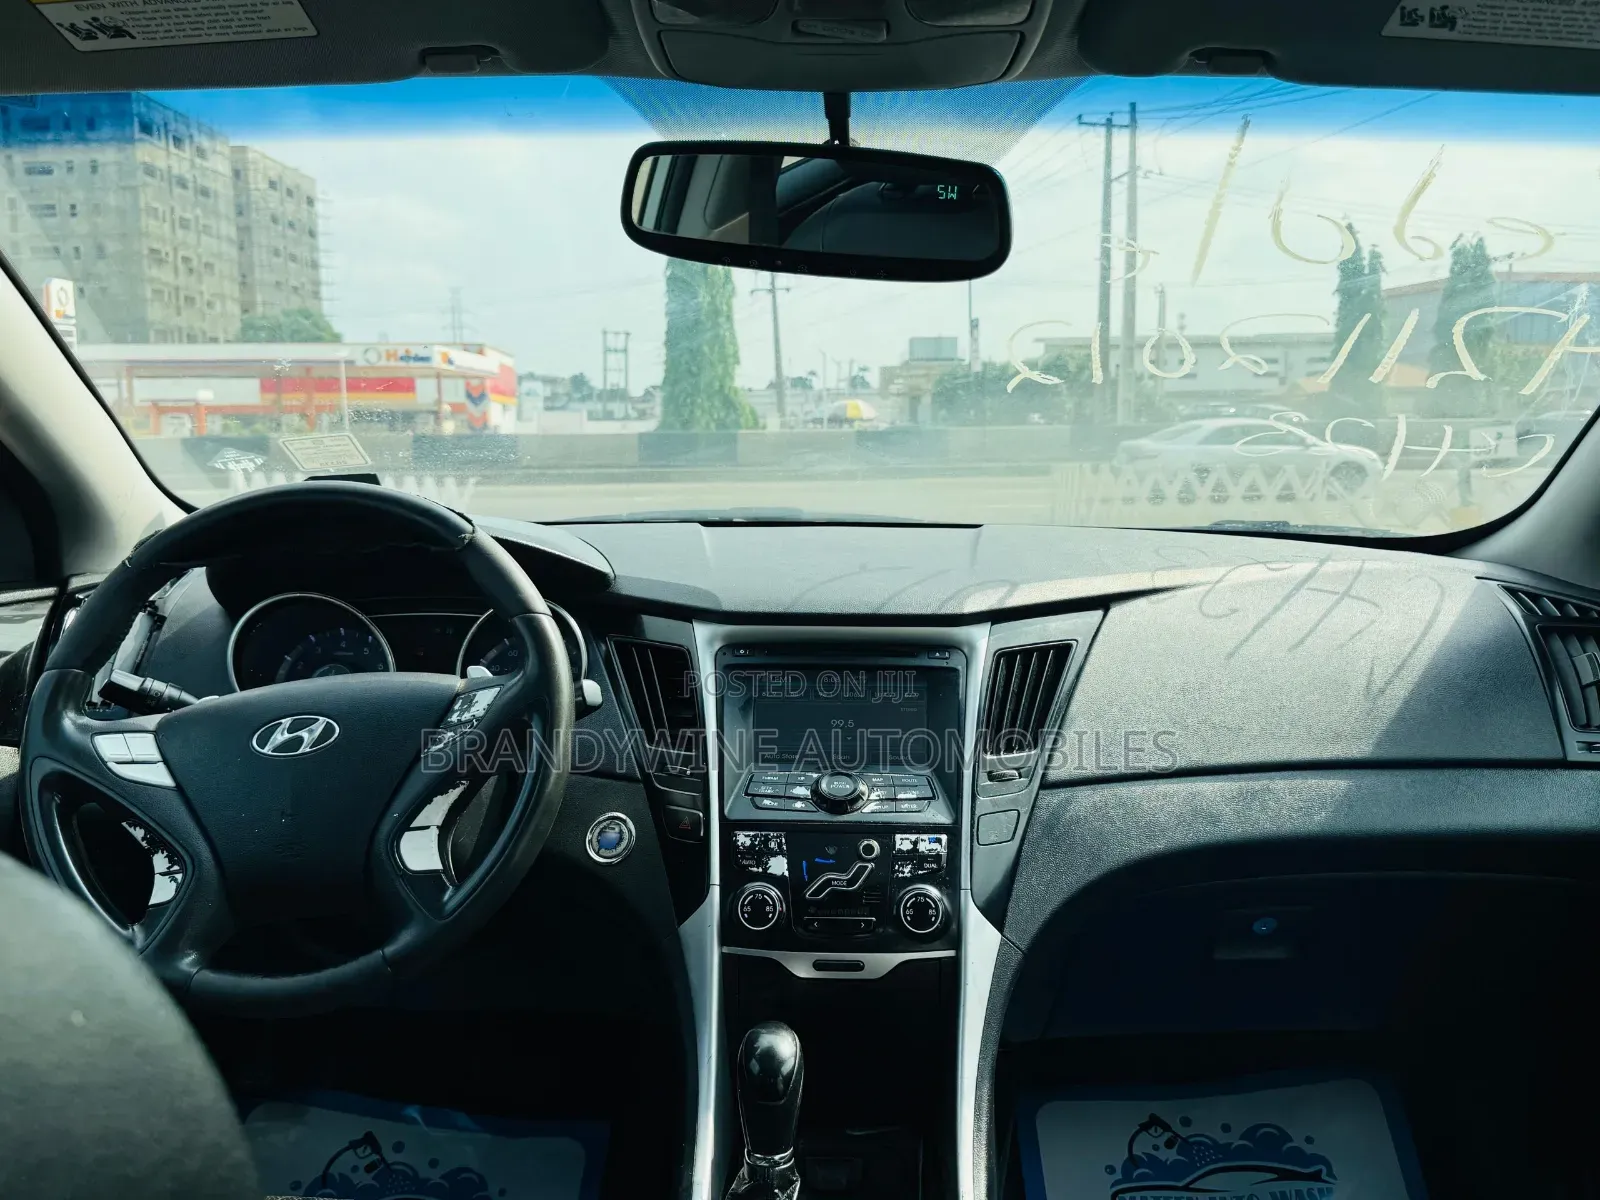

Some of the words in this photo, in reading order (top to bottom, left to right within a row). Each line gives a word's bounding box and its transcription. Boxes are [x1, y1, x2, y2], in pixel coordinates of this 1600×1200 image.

[74, 3, 106, 11] EVEN
[109, 0, 138, 8] WITH
[937, 185, 957, 199] SW
[830, 719, 855, 728] 99.5
